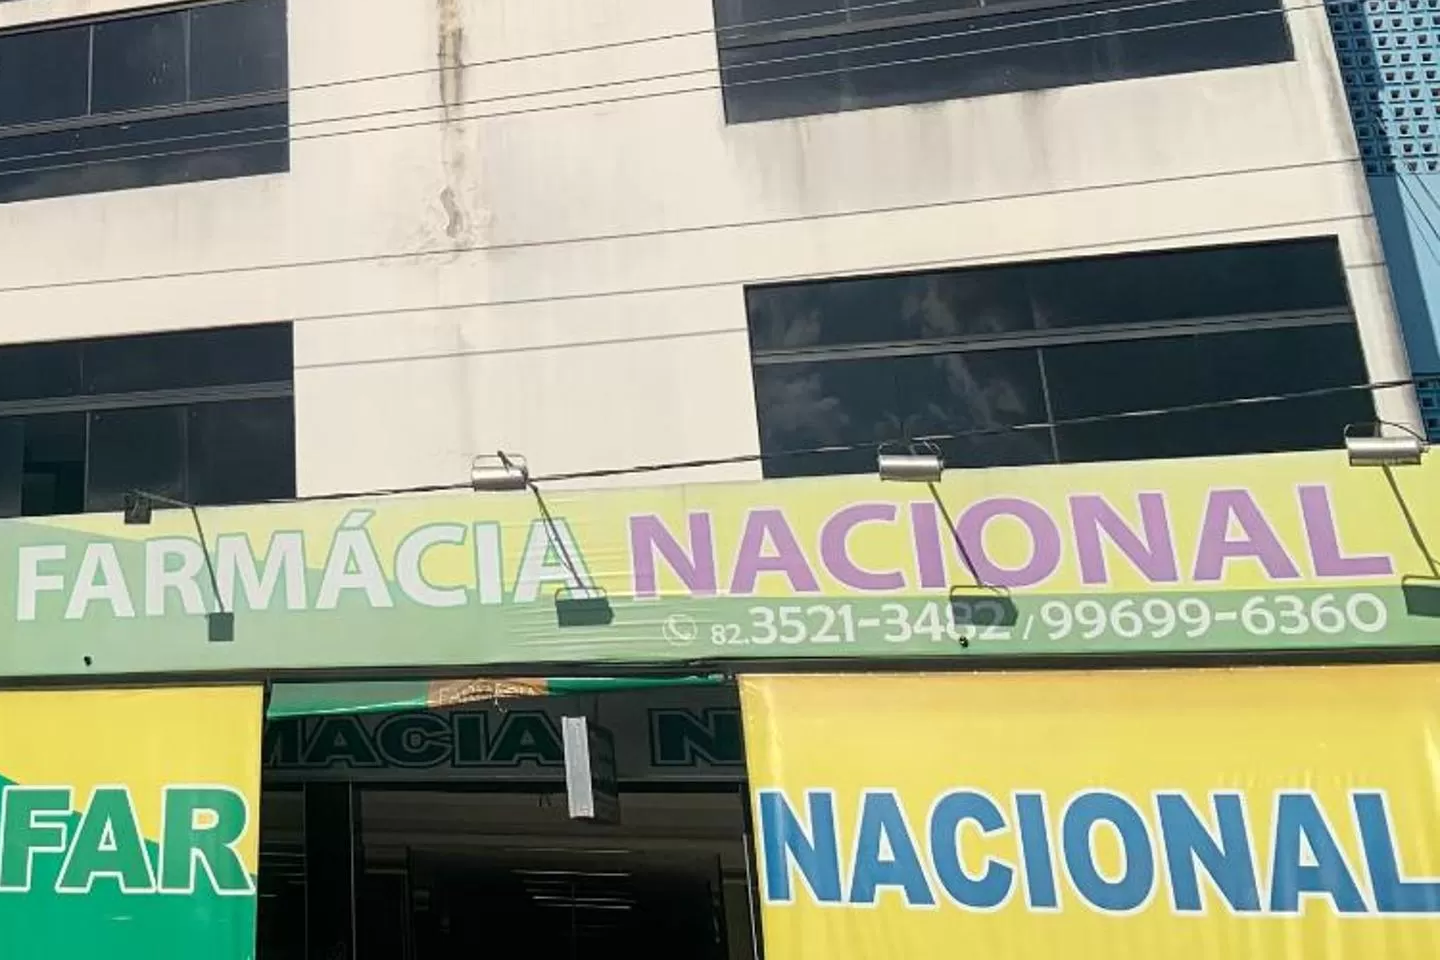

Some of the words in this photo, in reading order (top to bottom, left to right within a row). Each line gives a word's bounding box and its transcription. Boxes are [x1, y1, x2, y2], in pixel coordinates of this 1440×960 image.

[15, 510, 587, 623] FARMÁCIA
[628, 484, 1394, 603] NACIONAL
[757, 786, 1440, 916] NACIONAL
